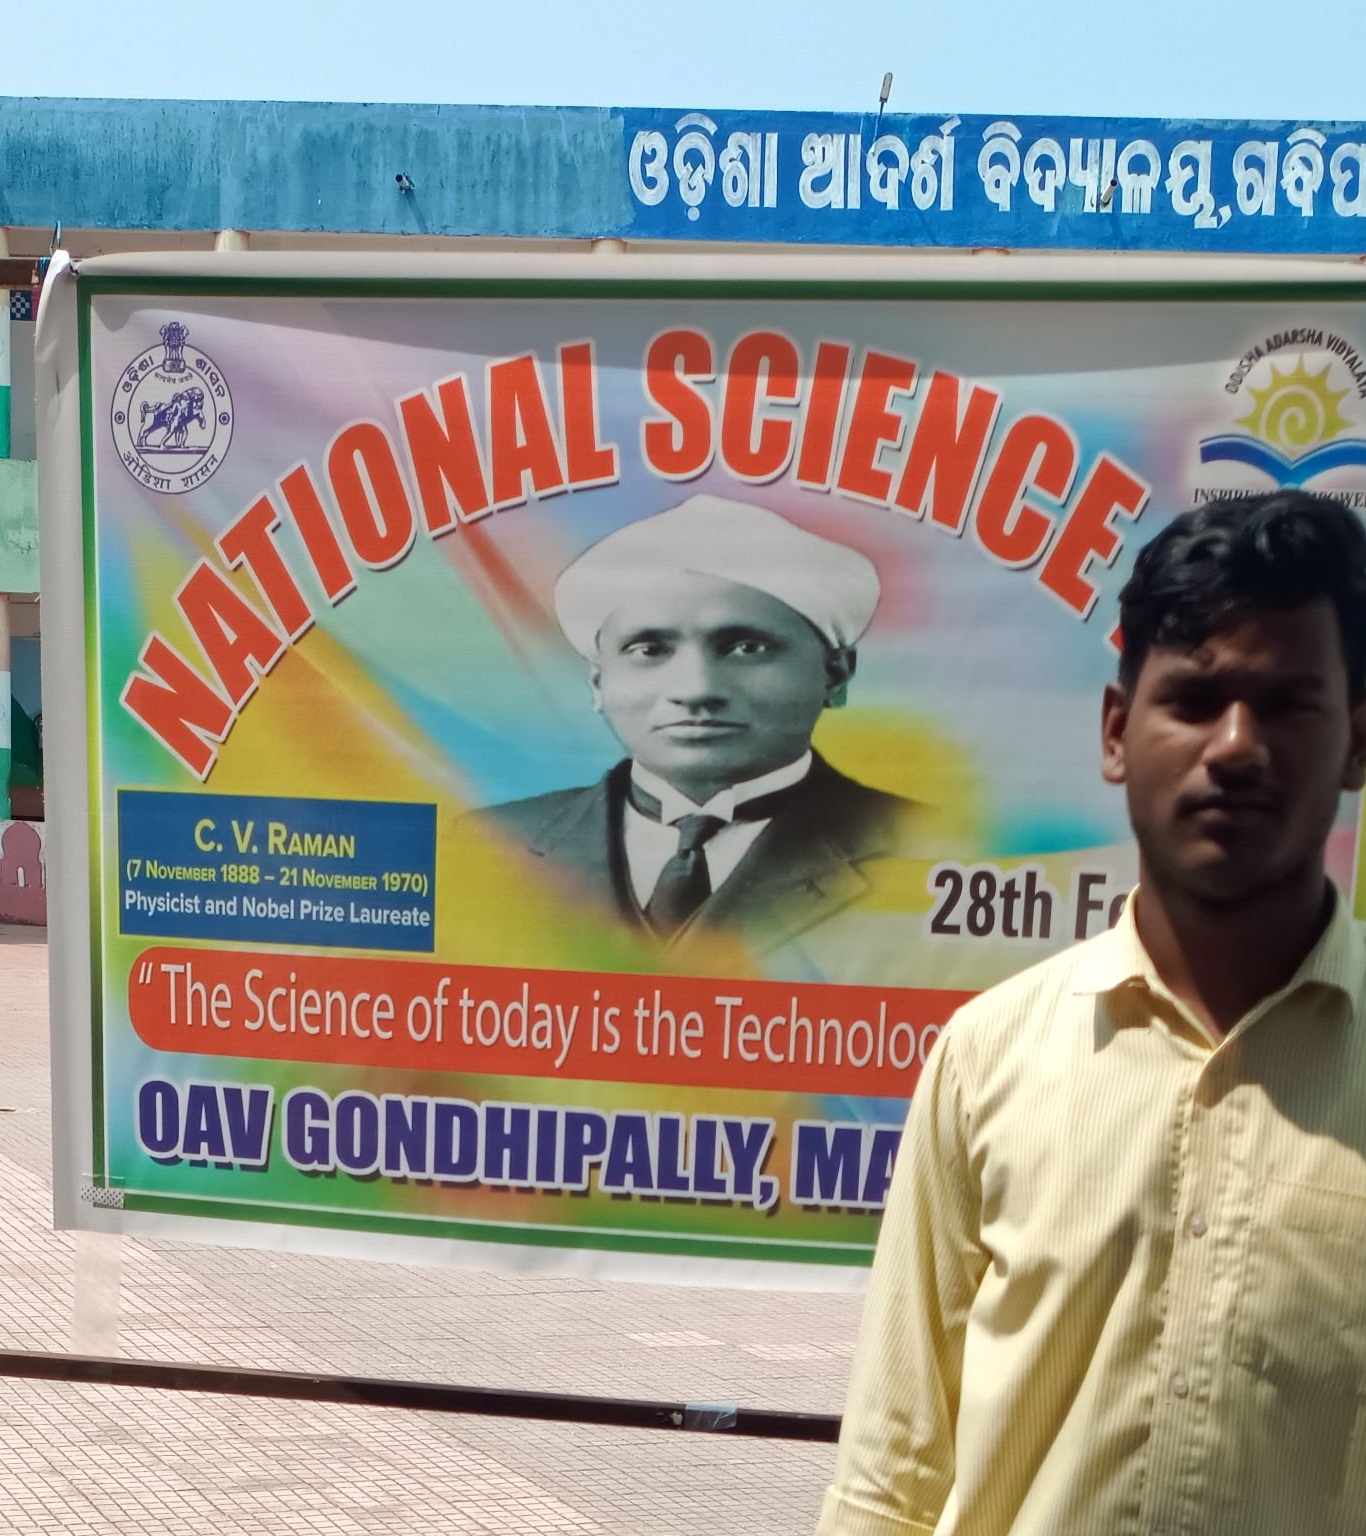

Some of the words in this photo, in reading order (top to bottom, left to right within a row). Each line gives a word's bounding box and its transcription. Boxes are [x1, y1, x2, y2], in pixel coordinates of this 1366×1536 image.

[628, 112, 779, 221] ଓଡ଼ିଶା
[799, 114, 962, 211] ଆଦର୍ଶ
[1225, 345, 1267, 394] ODISHA
[1265, 328, 1324, 353] ADARSHA
[123, 451, 171, 490] ओडिशा
[181, 453, 218, 488] शासन
[128, 346, 613, 772] NATIONAL
[647, 333, 1142, 610] SCIENCE
[194, 818, 223, 852] C.
[232, 820, 258, 855] V.
[268, 822, 355, 858] RAMAN
[125, 890, 200, 917] Physicist
[205, 895, 236, 915] and
[243, 897, 295, 920] Nobel
[300, 900, 345, 922] Prize
[350, 903, 430, 927] Laureate
[127, 859, 141, 881] (7
[146, 860, 216, 883] NOVEMBER
[220, 863, 260, 884] 1888
[280, 867, 298, 885] 21
[303, 868, 377, 890] NOVEMBER
[382, 873, 428, 897] 1970)
[931, 869, 1052, 939] 28th
[245, 969, 395, 1040] Science
[407, 977, 450, 1043] of
[460, 982, 580, 1068] today
[591, 990, 620, 1054] is
[635, 990, 704, 1058] the
[140, 1081, 268, 1157] OAV
[288, 1093, 772, 1201] GONDHIPALLY,
[797, 1127, 899, 1200] MA
